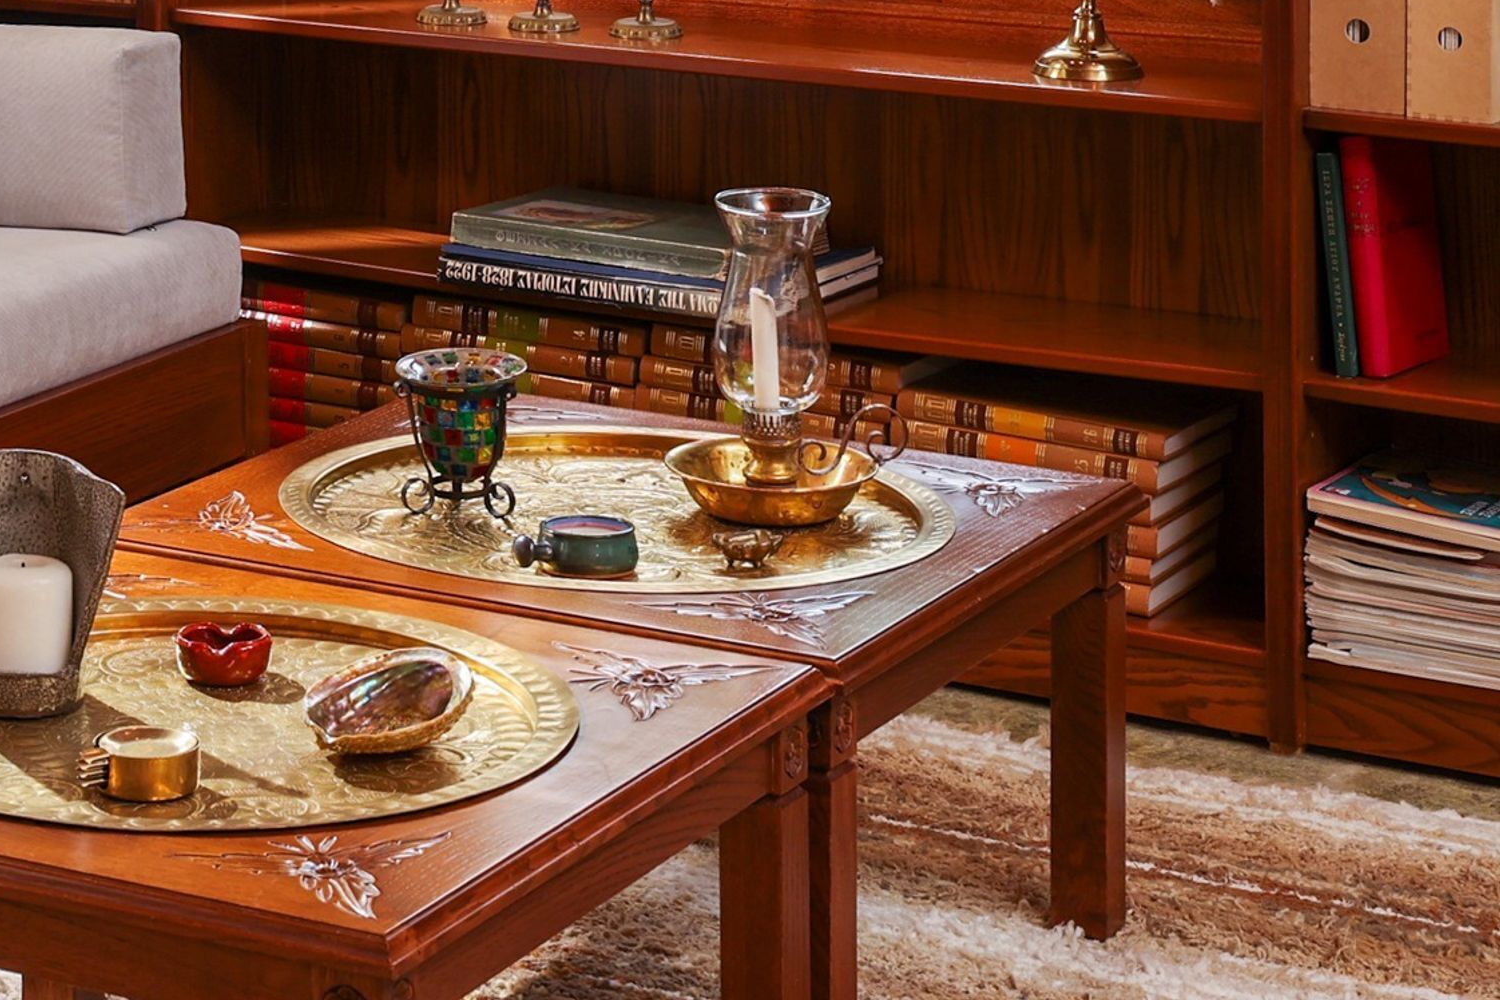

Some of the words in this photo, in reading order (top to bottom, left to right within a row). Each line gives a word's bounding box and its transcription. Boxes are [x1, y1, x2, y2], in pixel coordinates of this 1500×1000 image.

[1323, 170, 1332, 196] ΙΕΡΑ
[1325, 200, 1336, 236] ΣΚΗΤΗ
[1328, 240, 1340, 271] ΑΓΙΟΥ
[446, 261, 514, 287] 1828-1922
[516, 270, 576, 295] ΙΣΤΟΡΙΑΣ
[580, 279, 654, 305] ΕΛΛΗΝΙΚΗΣ
[658, 289, 686, 310] ΤΗΣ
[1332, 276, 1344, 318] ΑΝΔΡΕΑ
